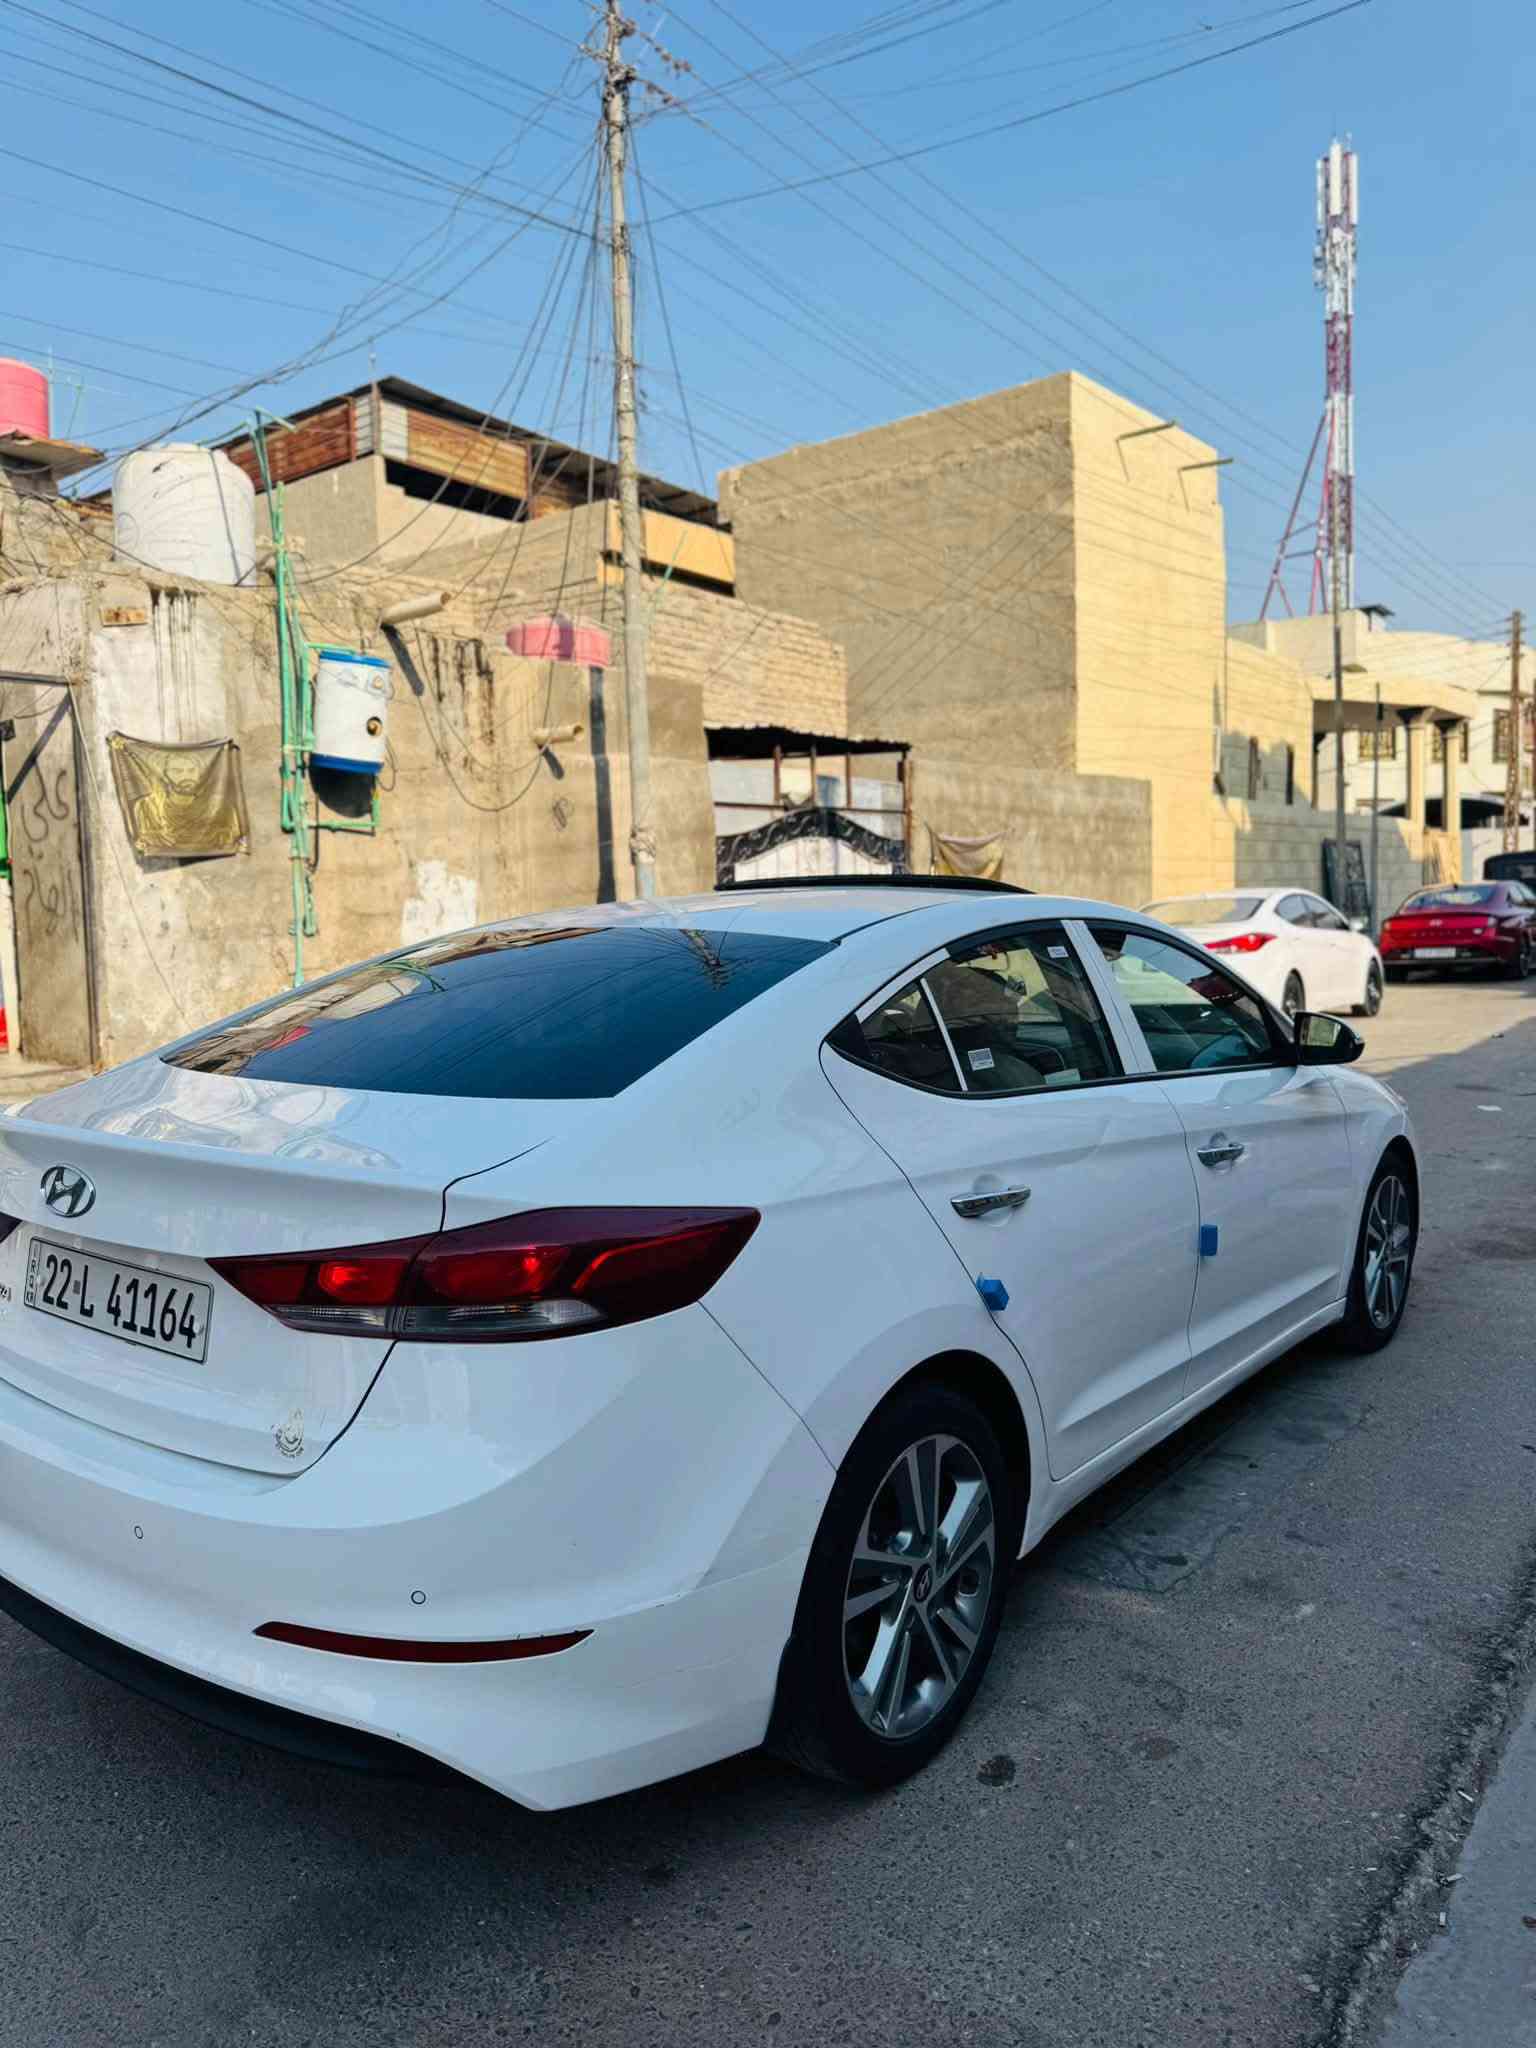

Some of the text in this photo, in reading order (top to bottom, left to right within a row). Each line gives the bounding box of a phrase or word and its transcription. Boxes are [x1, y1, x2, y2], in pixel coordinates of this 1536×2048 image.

[42, 1253, 196, 1349] 22 L 41164
